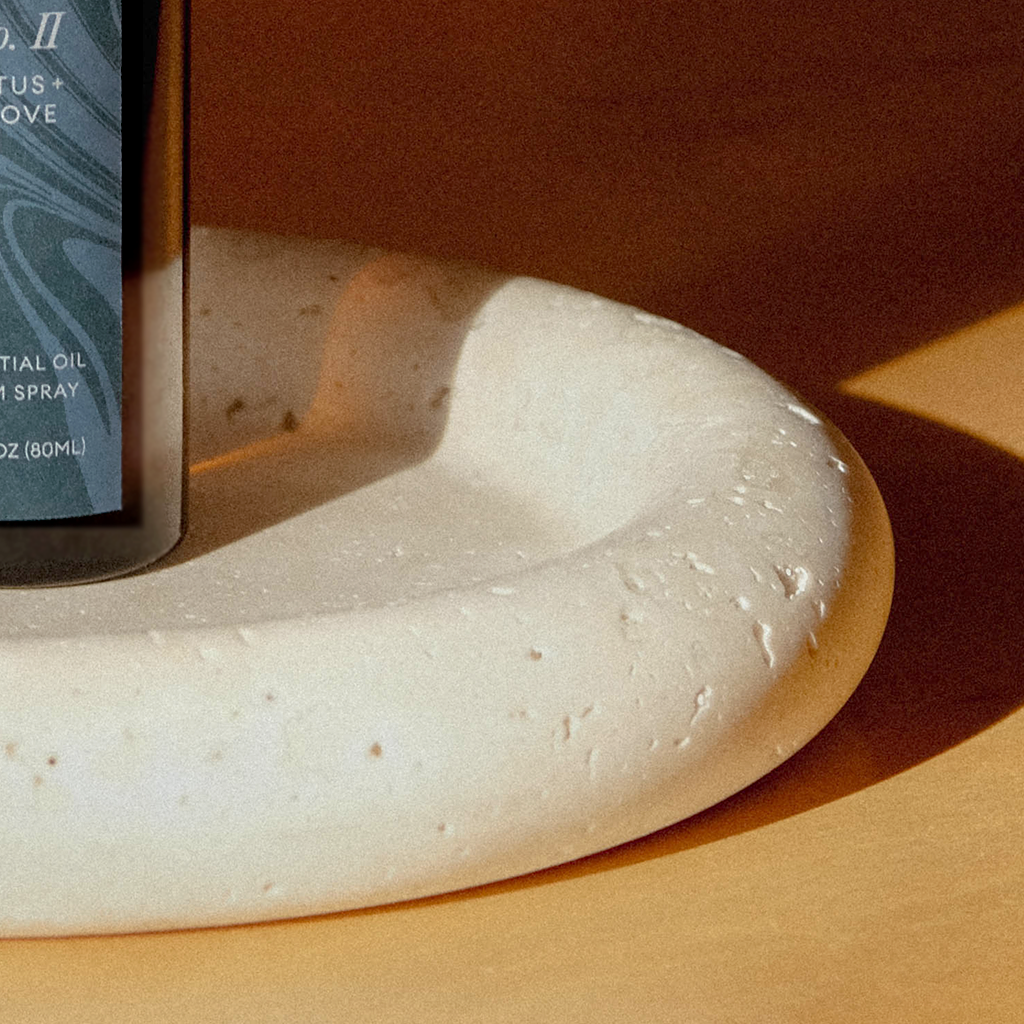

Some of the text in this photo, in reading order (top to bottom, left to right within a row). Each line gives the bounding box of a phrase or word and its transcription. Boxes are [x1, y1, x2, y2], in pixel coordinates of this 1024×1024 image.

[29, 12, 67, 50] II
[52, 352, 86, 371] OIL
[14, 382, 79, 401] SPRAY
[24, 436, 86, 461] (80ML)
